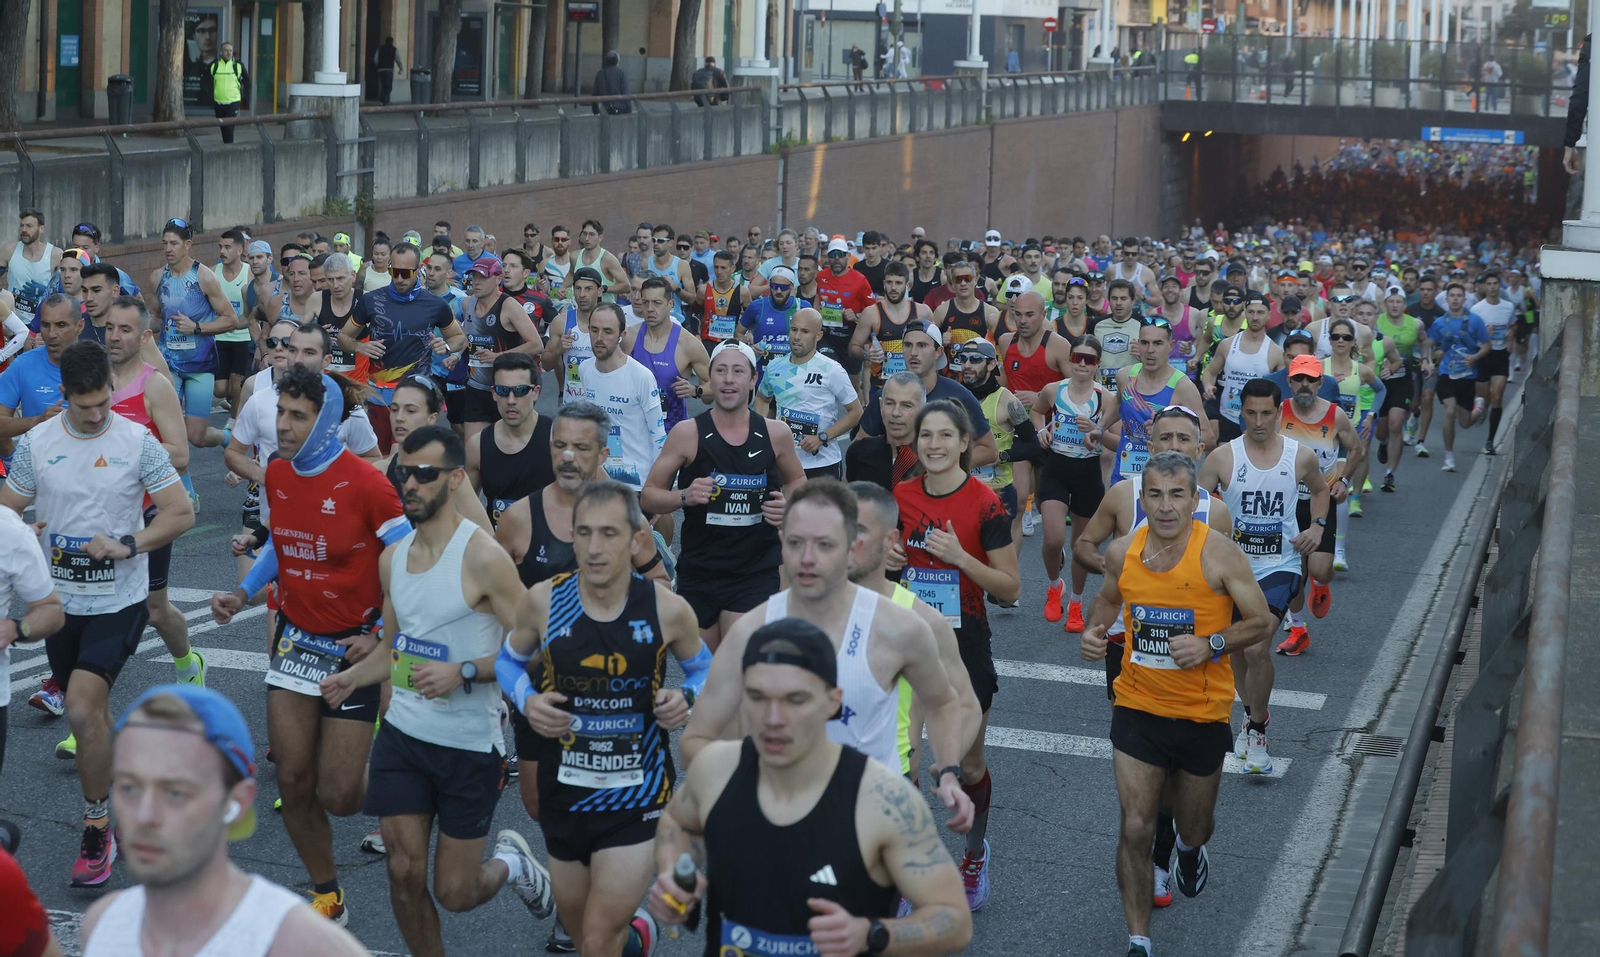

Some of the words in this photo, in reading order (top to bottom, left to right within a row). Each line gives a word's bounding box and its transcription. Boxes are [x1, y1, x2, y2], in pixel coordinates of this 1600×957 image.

[15, 303, 32, 313] PEDRO
[169, 335, 187, 343] DAVID
[1230, 370, 1258, 378] SEVILLA
[609, 395, 630, 404] 2XU
[791, 412, 815, 421] ZURICH
[1054, 433, 1083, 445] MAGDALE
[730, 478, 763, 486] ZURICH
[730, 492, 748, 500] 4004
[725, 502, 751, 514] IVAN
[1241, 490, 1285, 517] ENA
[280, 528, 314, 541] GENERALI
[282, 543, 316, 561] MÁLAGA
[71, 557, 91, 566] 3752
[52, 566, 75, 580] ERIC
[85, 569, 115, 582] LIAM
[917, 571, 953, 582] ZURICH
[918, 589, 937, 599] 7545
[1149, 610, 1187, 621] ZURICH
[1150, 628, 1169, 639] 3151
[303, 635, 340, 653] ZURICH
[847, 624, 862, 657] soar
[407, 641, 442, 658] ZURICH
[1138, 639, 1171, 655] IOANN
[300, 652, 320, 665] 4171
[279, 658, 328, 683] IDALINO
[586, 719, 635, 731] ZURICH
